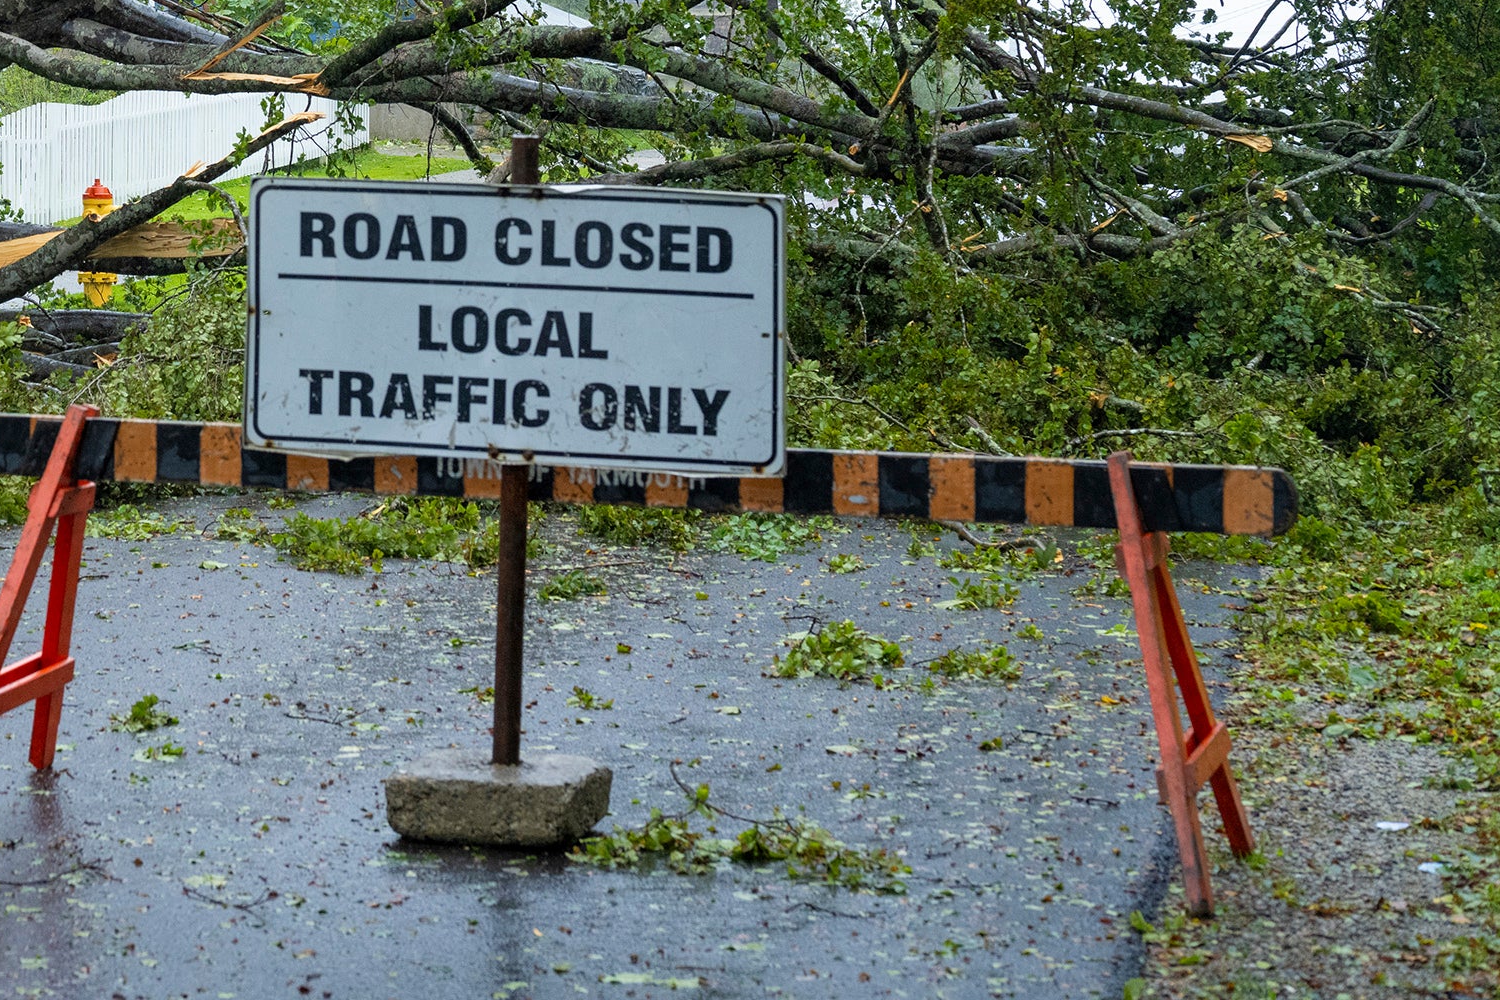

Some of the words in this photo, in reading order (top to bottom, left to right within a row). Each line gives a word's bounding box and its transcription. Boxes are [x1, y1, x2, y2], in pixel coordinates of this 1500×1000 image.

[299, 211, 468, 263] ROAD
[494, 217, 733, 274] CLOSED
[418, 304, 609, 360] LOCAL
[299, 368, 551, 428] TRAFFIC
[578, 382, 731, 437] ONLY
